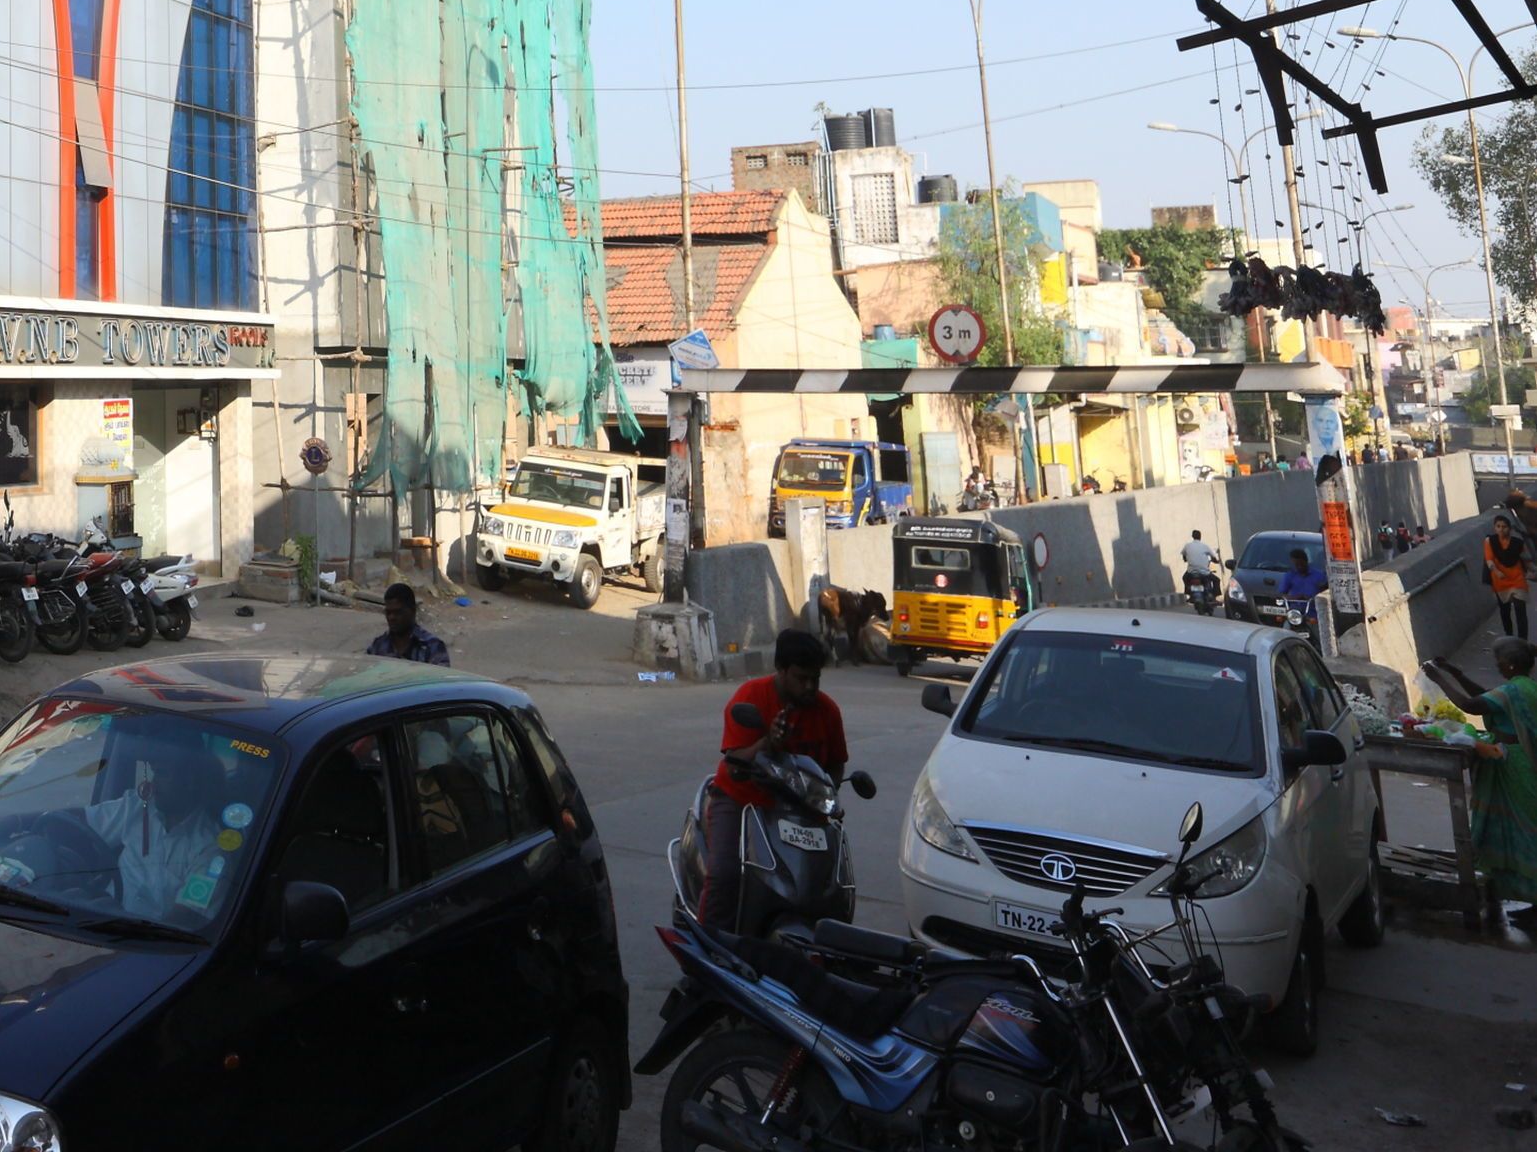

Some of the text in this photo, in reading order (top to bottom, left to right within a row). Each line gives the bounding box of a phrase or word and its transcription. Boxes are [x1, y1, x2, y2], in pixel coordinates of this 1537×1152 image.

[96, 318, 232, 367] TOWERS
[942, 325, 971, 340] 3 m
[230, 739, 271, 759] PRESS
